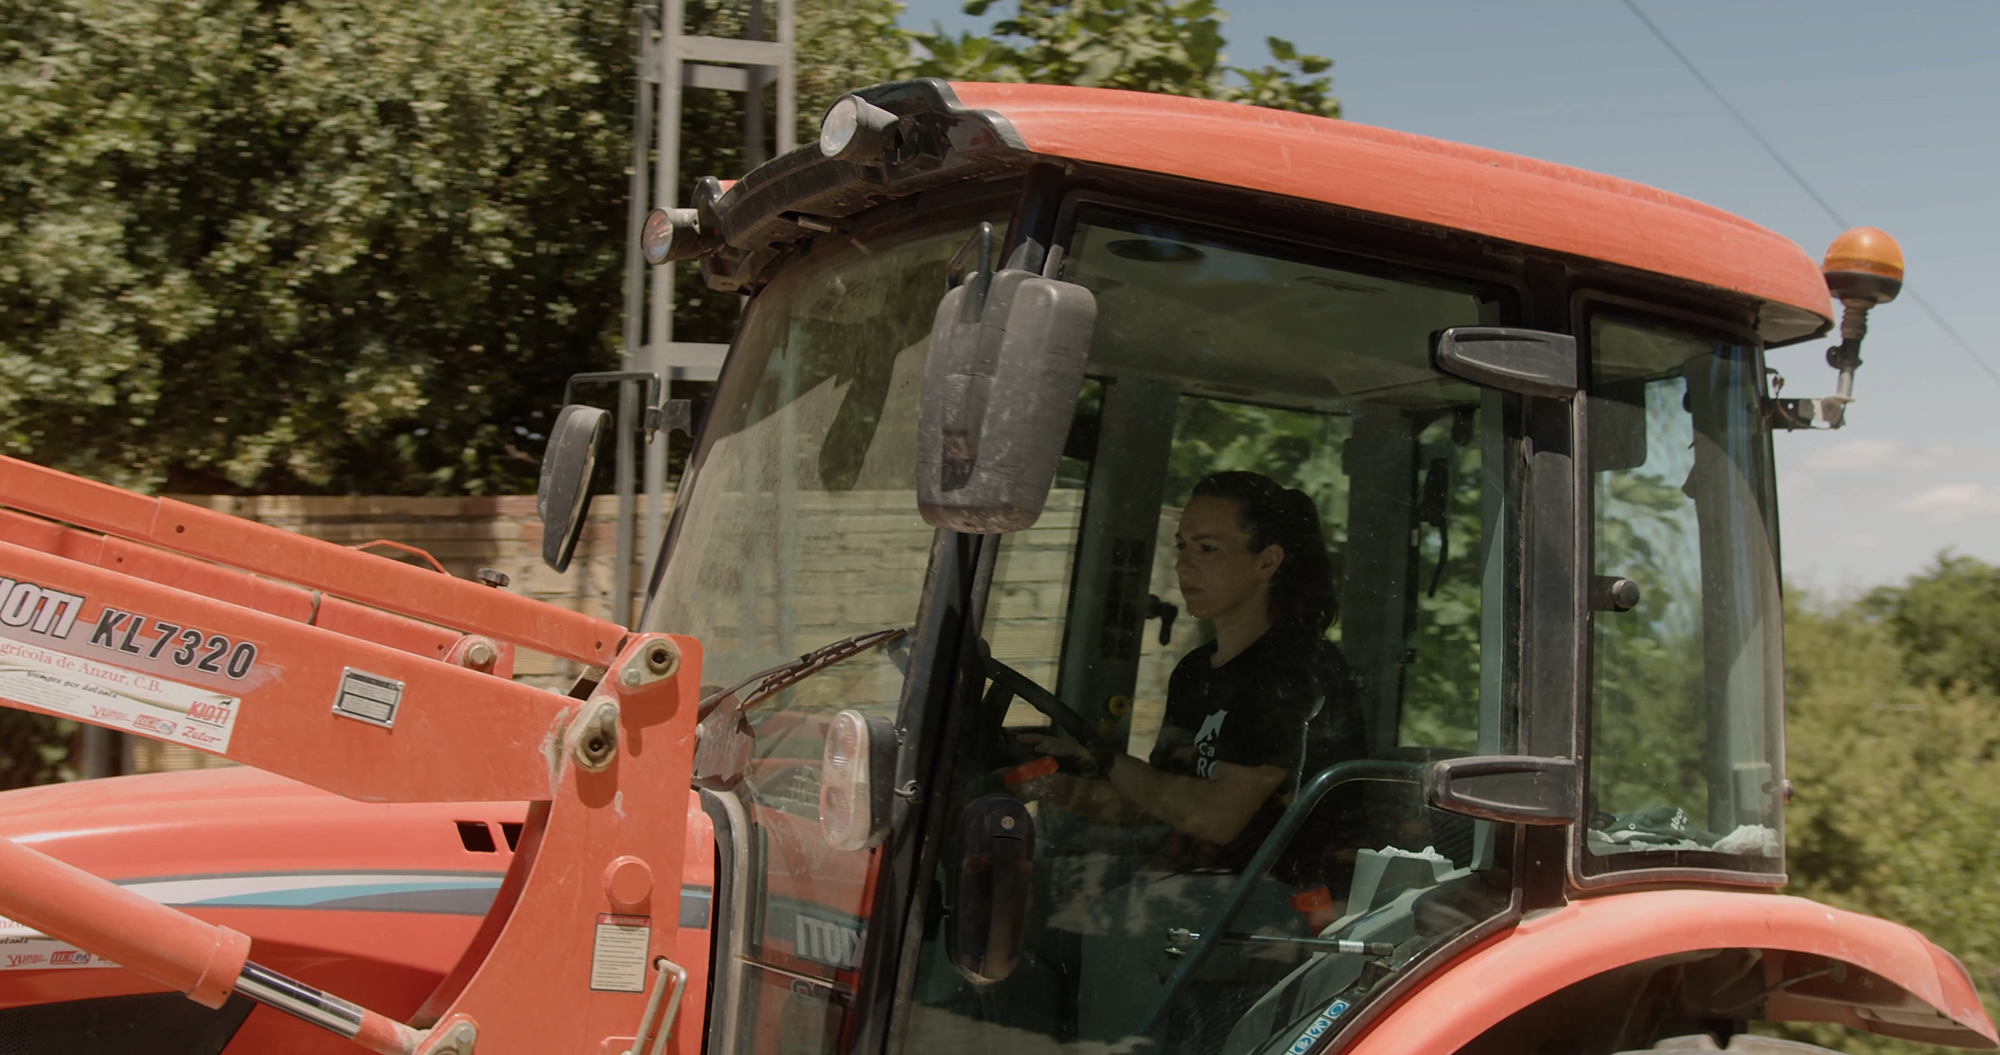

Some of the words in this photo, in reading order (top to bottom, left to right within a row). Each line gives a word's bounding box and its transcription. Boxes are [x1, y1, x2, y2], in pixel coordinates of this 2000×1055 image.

[0, 576, 85, 639] IOTI
[87, 608, 259, 680] KL7320
[0, 643, 51, 666] grícola
[56, 656, 75, 671] de
[133, 675, 163, 693] C.B.
[186, 701, 231, 726] KIOTI
